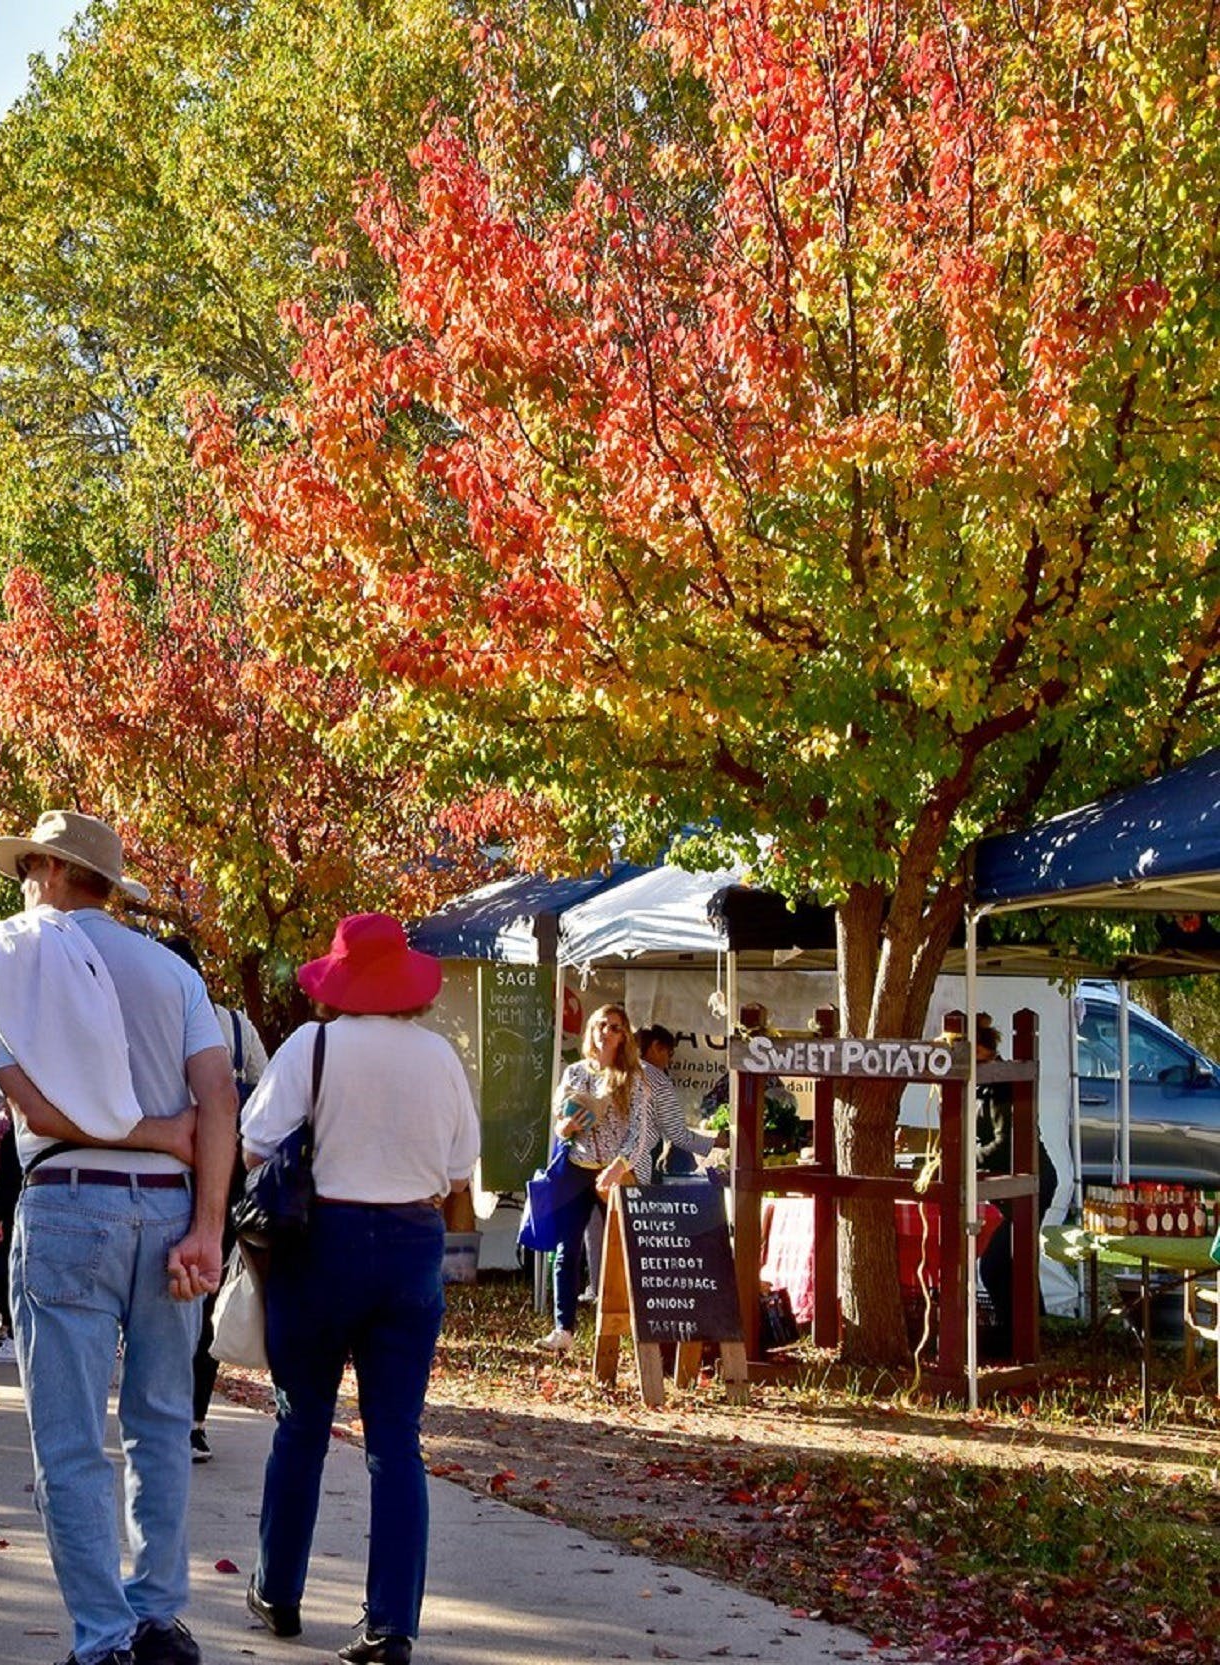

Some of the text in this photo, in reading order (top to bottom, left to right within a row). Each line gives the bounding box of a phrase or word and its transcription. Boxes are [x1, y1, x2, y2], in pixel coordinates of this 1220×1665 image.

[495, 971, 538, 986] SAGE
[743, 1036, 835, 1073] SWEET
[841, 1041, 952, 1076] POTATO
[668, 1058, 726, 1074] tainable
[633, 1220, 677, 1232] OLIVES
[640, 1257, 704, 1270] BEETROOT
[646, 1298, 696, 1310] ONIONS
